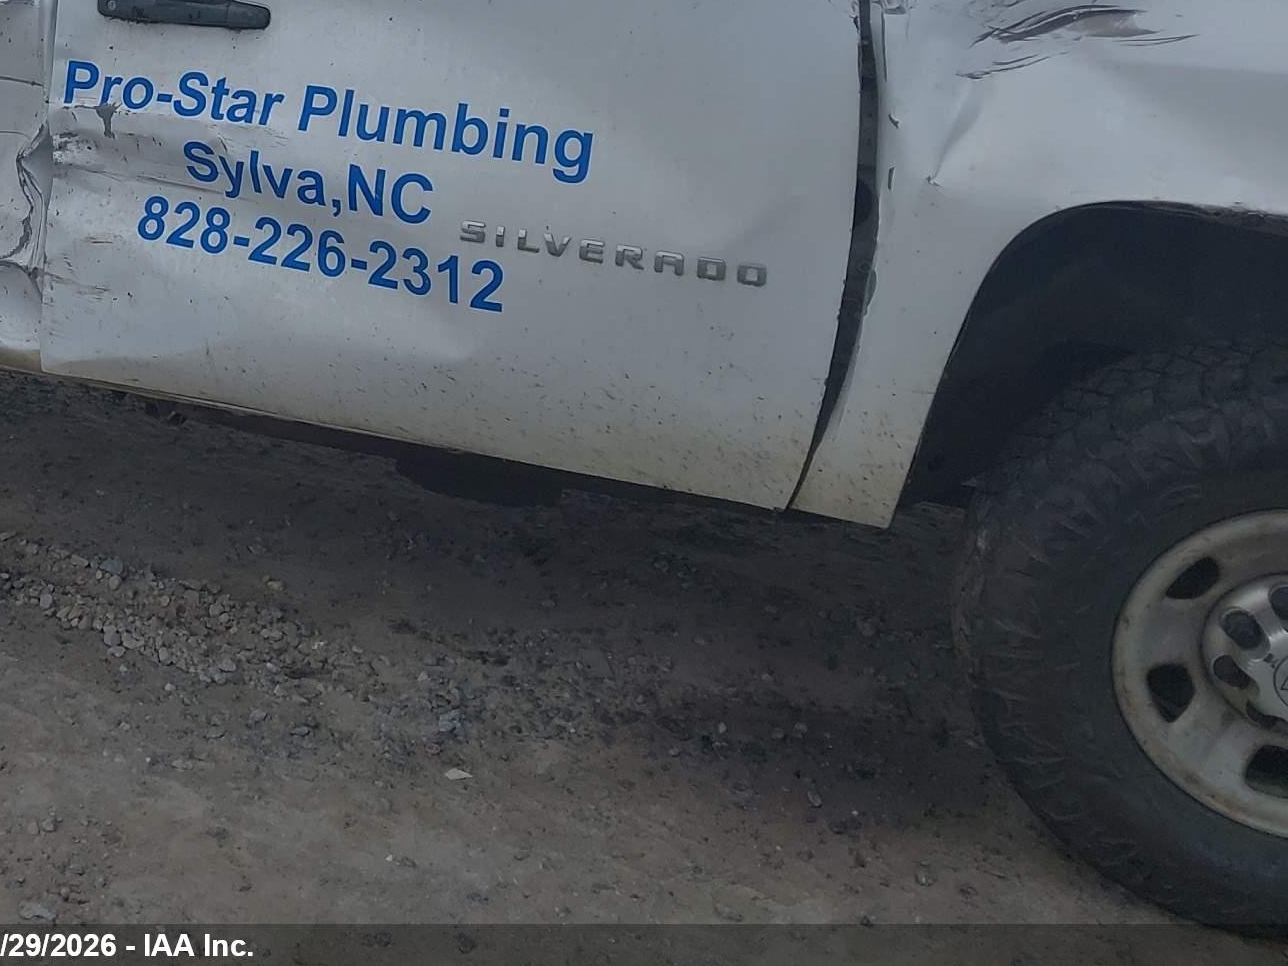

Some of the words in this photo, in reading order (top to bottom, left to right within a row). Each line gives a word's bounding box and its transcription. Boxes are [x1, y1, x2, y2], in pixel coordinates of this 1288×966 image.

[63, 59, 285, 126] Pro-Star
[297, 83, 595, 185] Plumbing
[183, 141, 434, 225] Sylva,NC
[136, 195, 506, 313] 828-226-2312
[460, 220, 767, 287] SILVERADO
